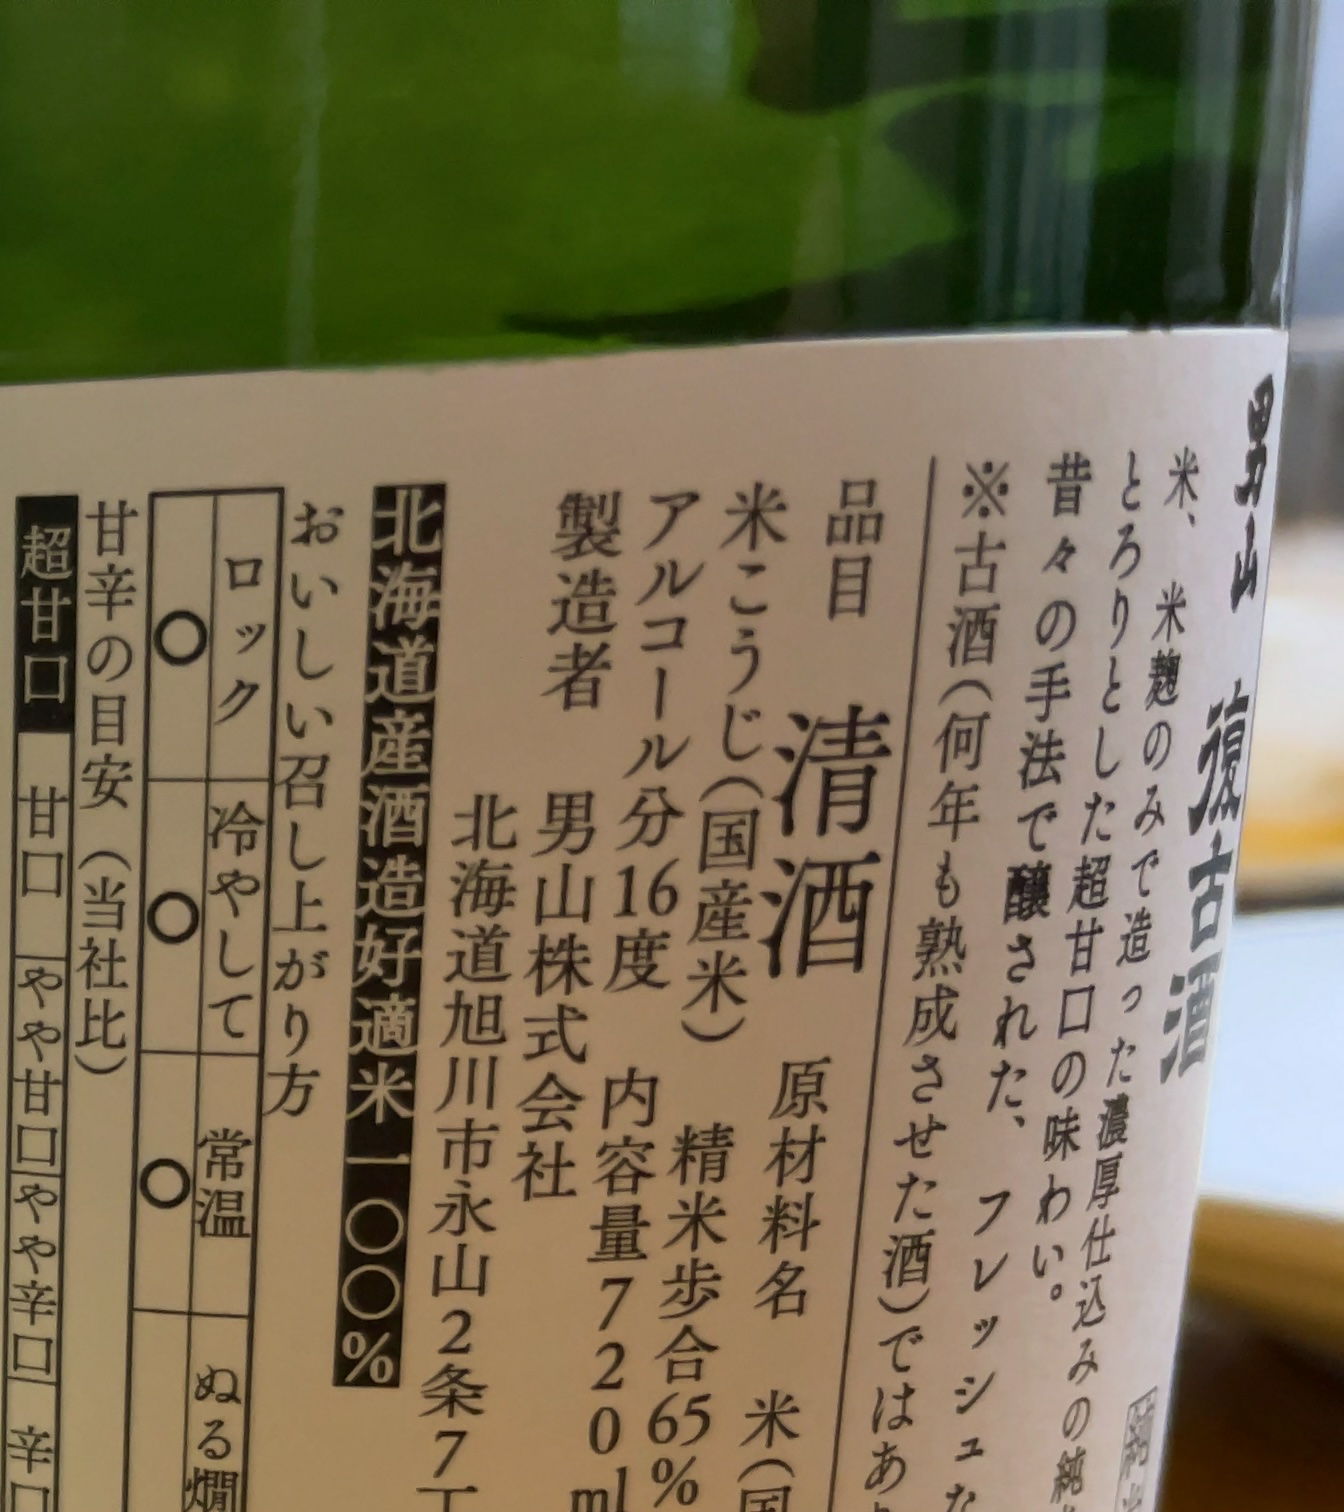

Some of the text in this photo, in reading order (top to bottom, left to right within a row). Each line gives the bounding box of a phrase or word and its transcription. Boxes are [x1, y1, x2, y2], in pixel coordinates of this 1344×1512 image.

[20, 523, 73, 705] 超甘口
[214, 556, 267, 725] ロック
[825, 479, 885, 621] 品目
[18, 785, 68, 898] 甘口
[263, 501, 344, 1117] おいしい召し上がり方
[511, 490, 623, 1202] 製造者 男山株式会社
[602, 490, 706, 993] アルコール分16度
[758, 704, 893, 979] 清酒
[1159, 373, 1274, 1085] 男山 復古酒
[208, 800, 266, 1040] 冷やして
[1032, 450, 1141, 1301] とろりとした超甘口の味わい。
[13, 966, 64, 1167] やや甘口
[195, 1128, 252, 1239] 常温
[11, 1182, 58, 1376] やや辛口
[754, 1056, 832, 1320] 原材料名
